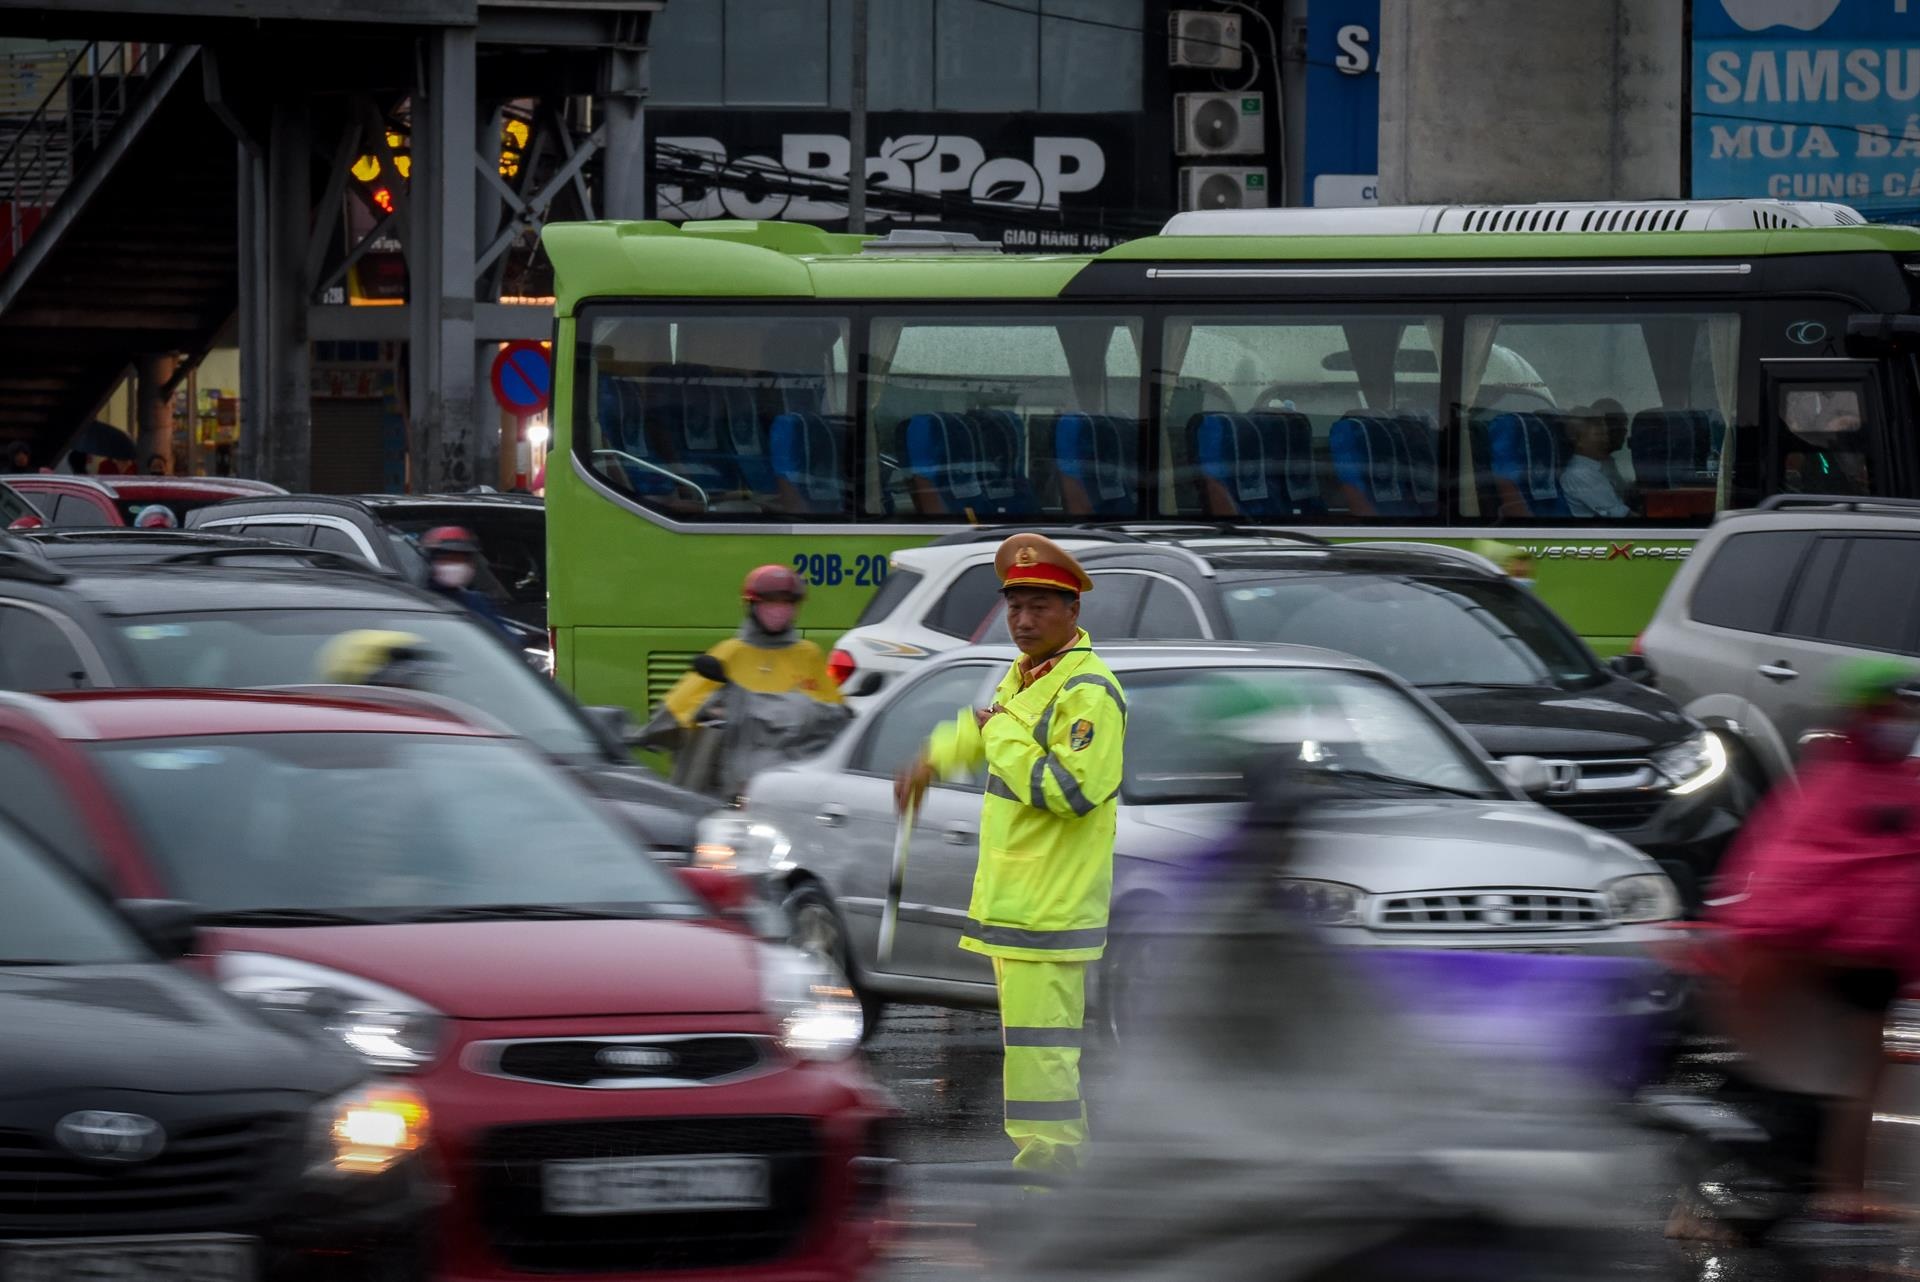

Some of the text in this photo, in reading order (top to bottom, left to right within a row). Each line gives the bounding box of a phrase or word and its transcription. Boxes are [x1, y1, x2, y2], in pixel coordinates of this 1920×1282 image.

[1335, 24, 1380, 75] S
[1709, 125, 1840, 159] MUA
[1767, 172, 1870, 198] CUNG
[1003, 229, 1037, 246] GIAO
[793, 553, 887, 586] 29B-20
